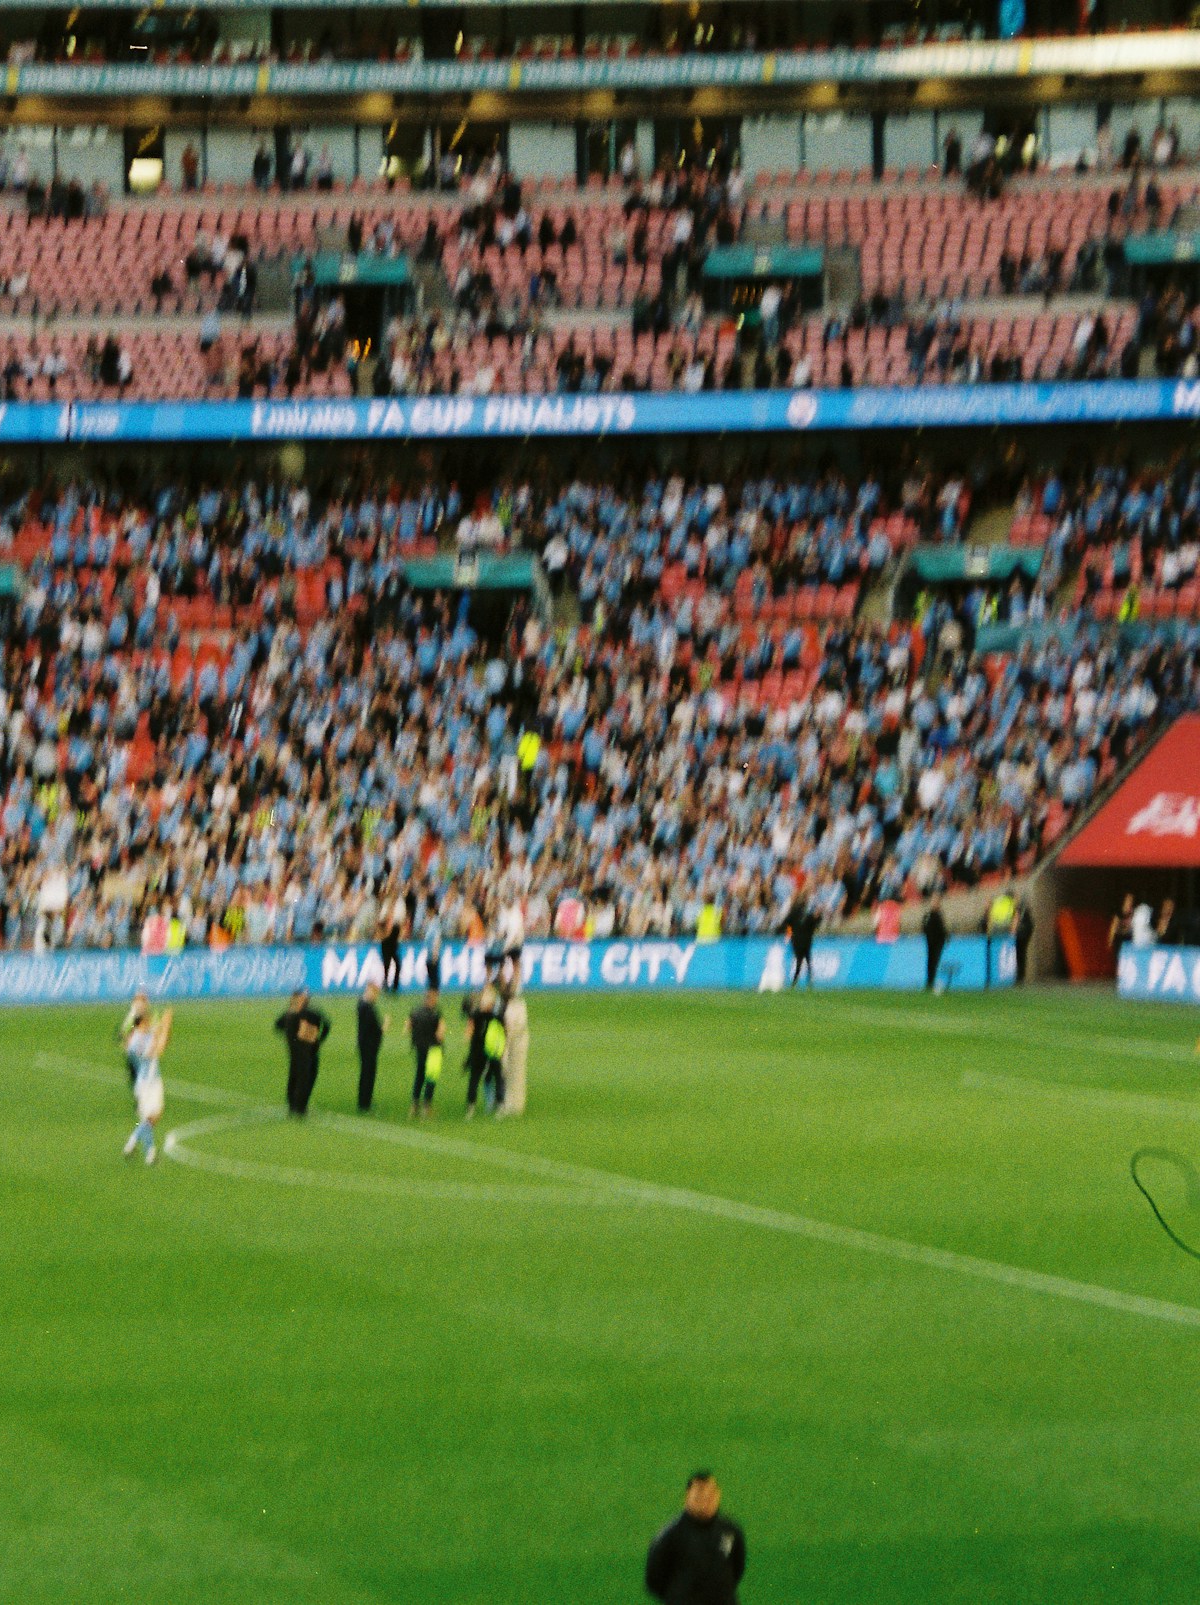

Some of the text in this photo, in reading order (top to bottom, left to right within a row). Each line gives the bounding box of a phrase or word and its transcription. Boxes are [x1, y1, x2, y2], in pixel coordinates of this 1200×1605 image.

[251, 395, 636, 437] Emirates FA CUP FINALISTS
[322, 944, 590, 988] MANCHETER
[601, 942, 695, 985] CITY
[1148, 950, 1187, 995] FA
